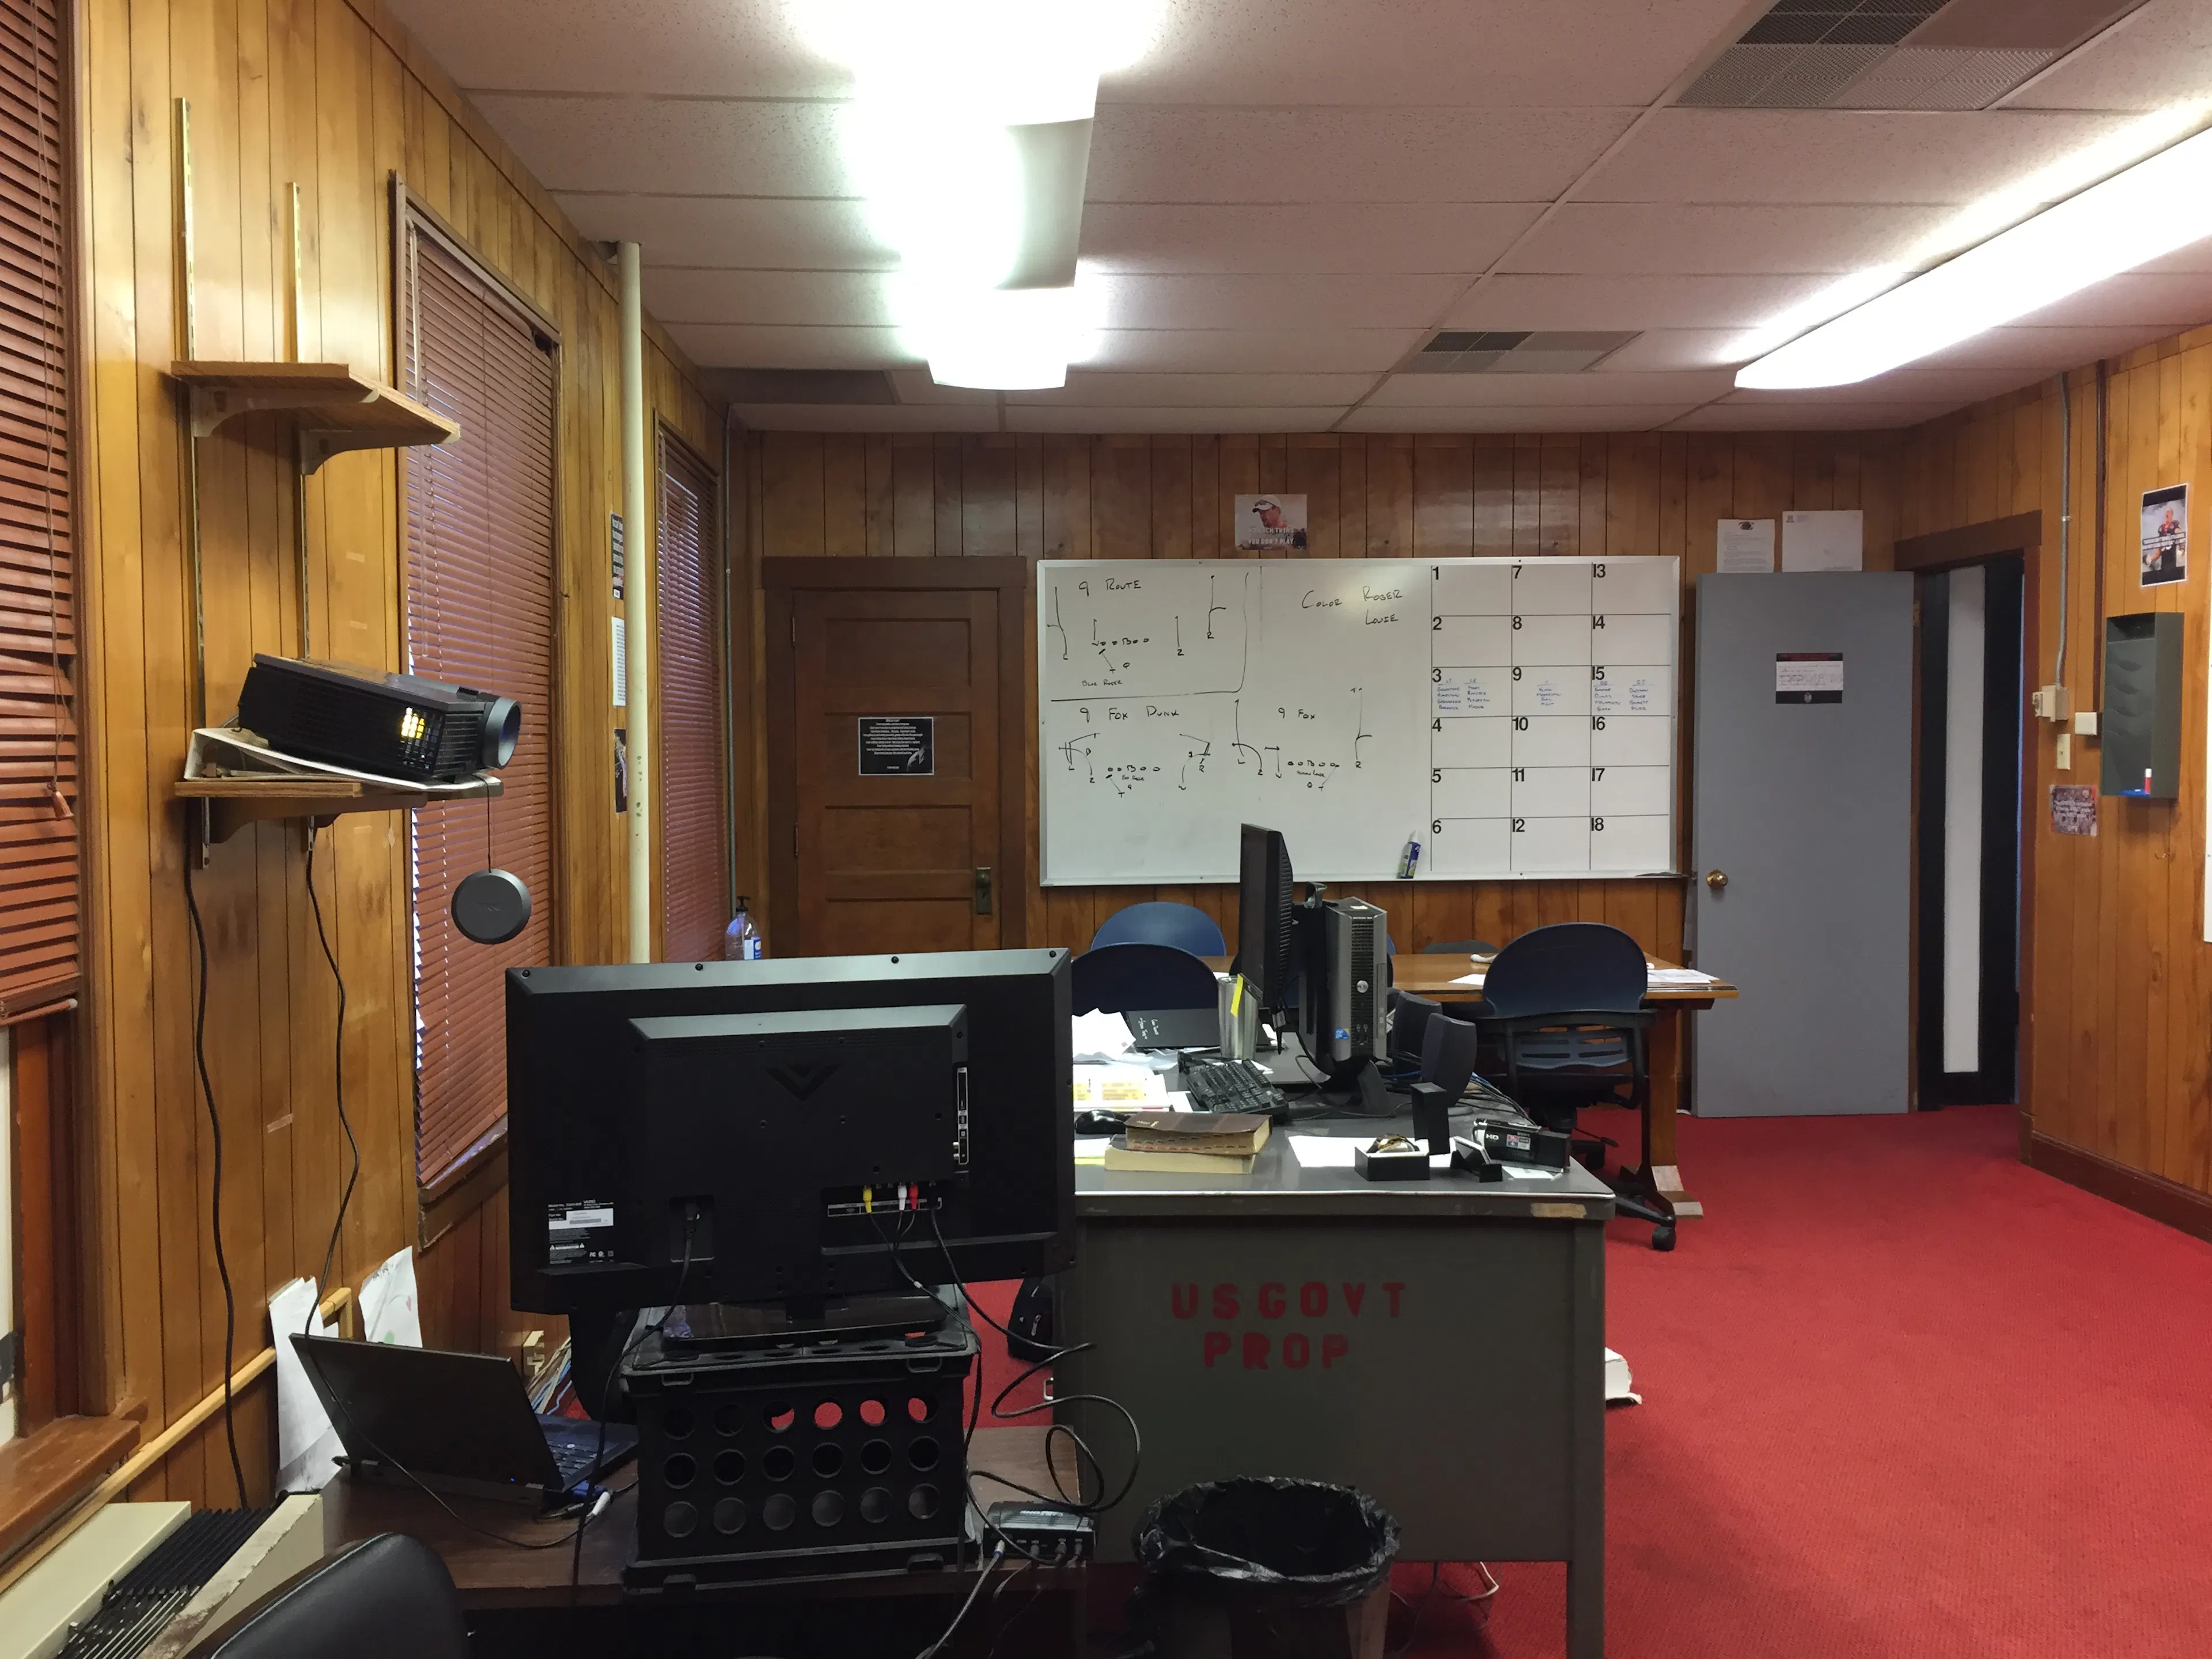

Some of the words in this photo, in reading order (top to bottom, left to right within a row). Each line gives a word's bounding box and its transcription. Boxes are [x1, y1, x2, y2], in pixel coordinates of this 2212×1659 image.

[1432, 566, 1440, 581] 1
[1512, 565, 1522, 579] 7
[1593, 563, 1607, 578] 13
[1078, 581, 1089, 597] 9
[1432, 616, 1442, 631] 2
[1512, 615, 1522, 631] 8
[1592, 615, 1605, 630] 14
[1431, 668, 1442, 683] 3
[1512, 665, 1522, 681] 9
[1592, 665, 1605, 681] 15
[1079, 707, 1090, 723] 9
[1108, 707, 1128, 720] FOX
[1277, 707, 1285, 719] 9
[1297, 708, 1315, 719] FOX
[1431, 718, 1442, 732] 4
[1512, 716, 1529, 732] 10
[1592, 715, 1606, 731] 16
[1431, 768, 1442, 783] 5
[1512, 768, 1525, 782] 11
[1591, 767, 1605, 782] 17
[1431, 819, 1442, 834] 6
[1512, 818, 1525, 833] 12
[1590, 817, 1604, 832] 18
[1204, 1331, 1349, 1370] PROP
